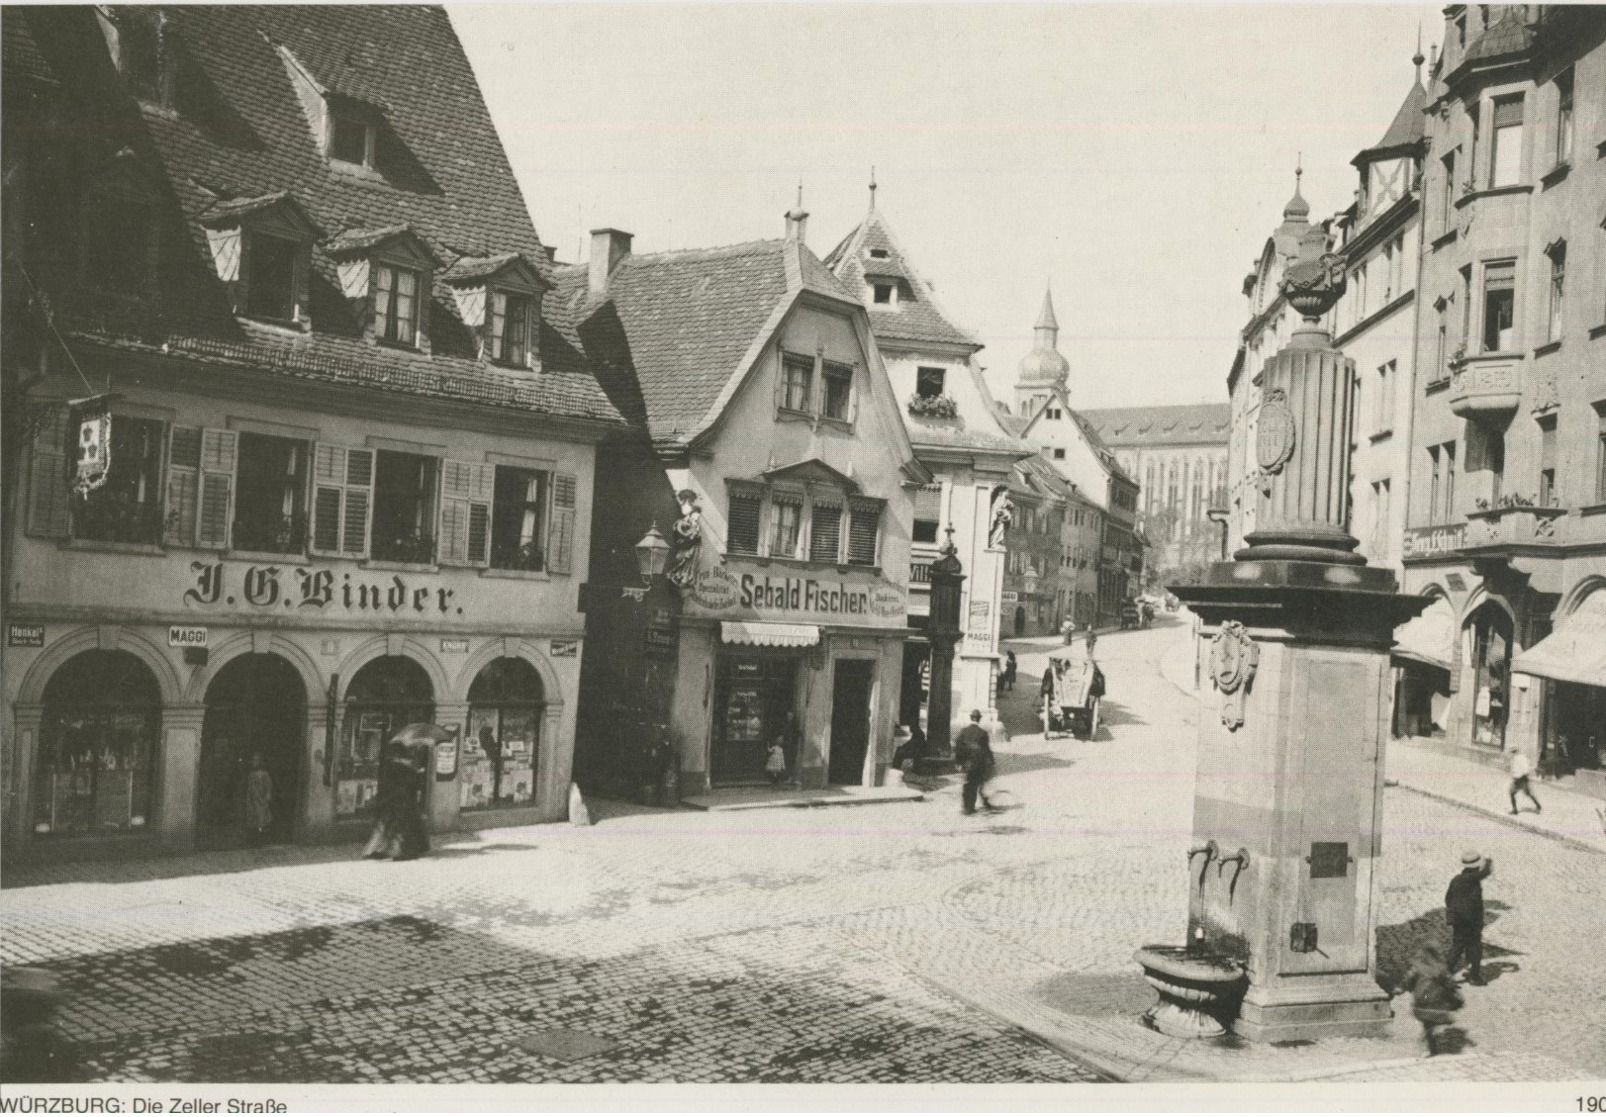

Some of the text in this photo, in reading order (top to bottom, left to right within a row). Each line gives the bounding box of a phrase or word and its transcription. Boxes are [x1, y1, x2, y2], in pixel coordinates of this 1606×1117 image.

[740, 573, 800, 610] Sebald
[170, 629, 206, 643] MAGGI
[967, 632, 991, 642] MAGGI
